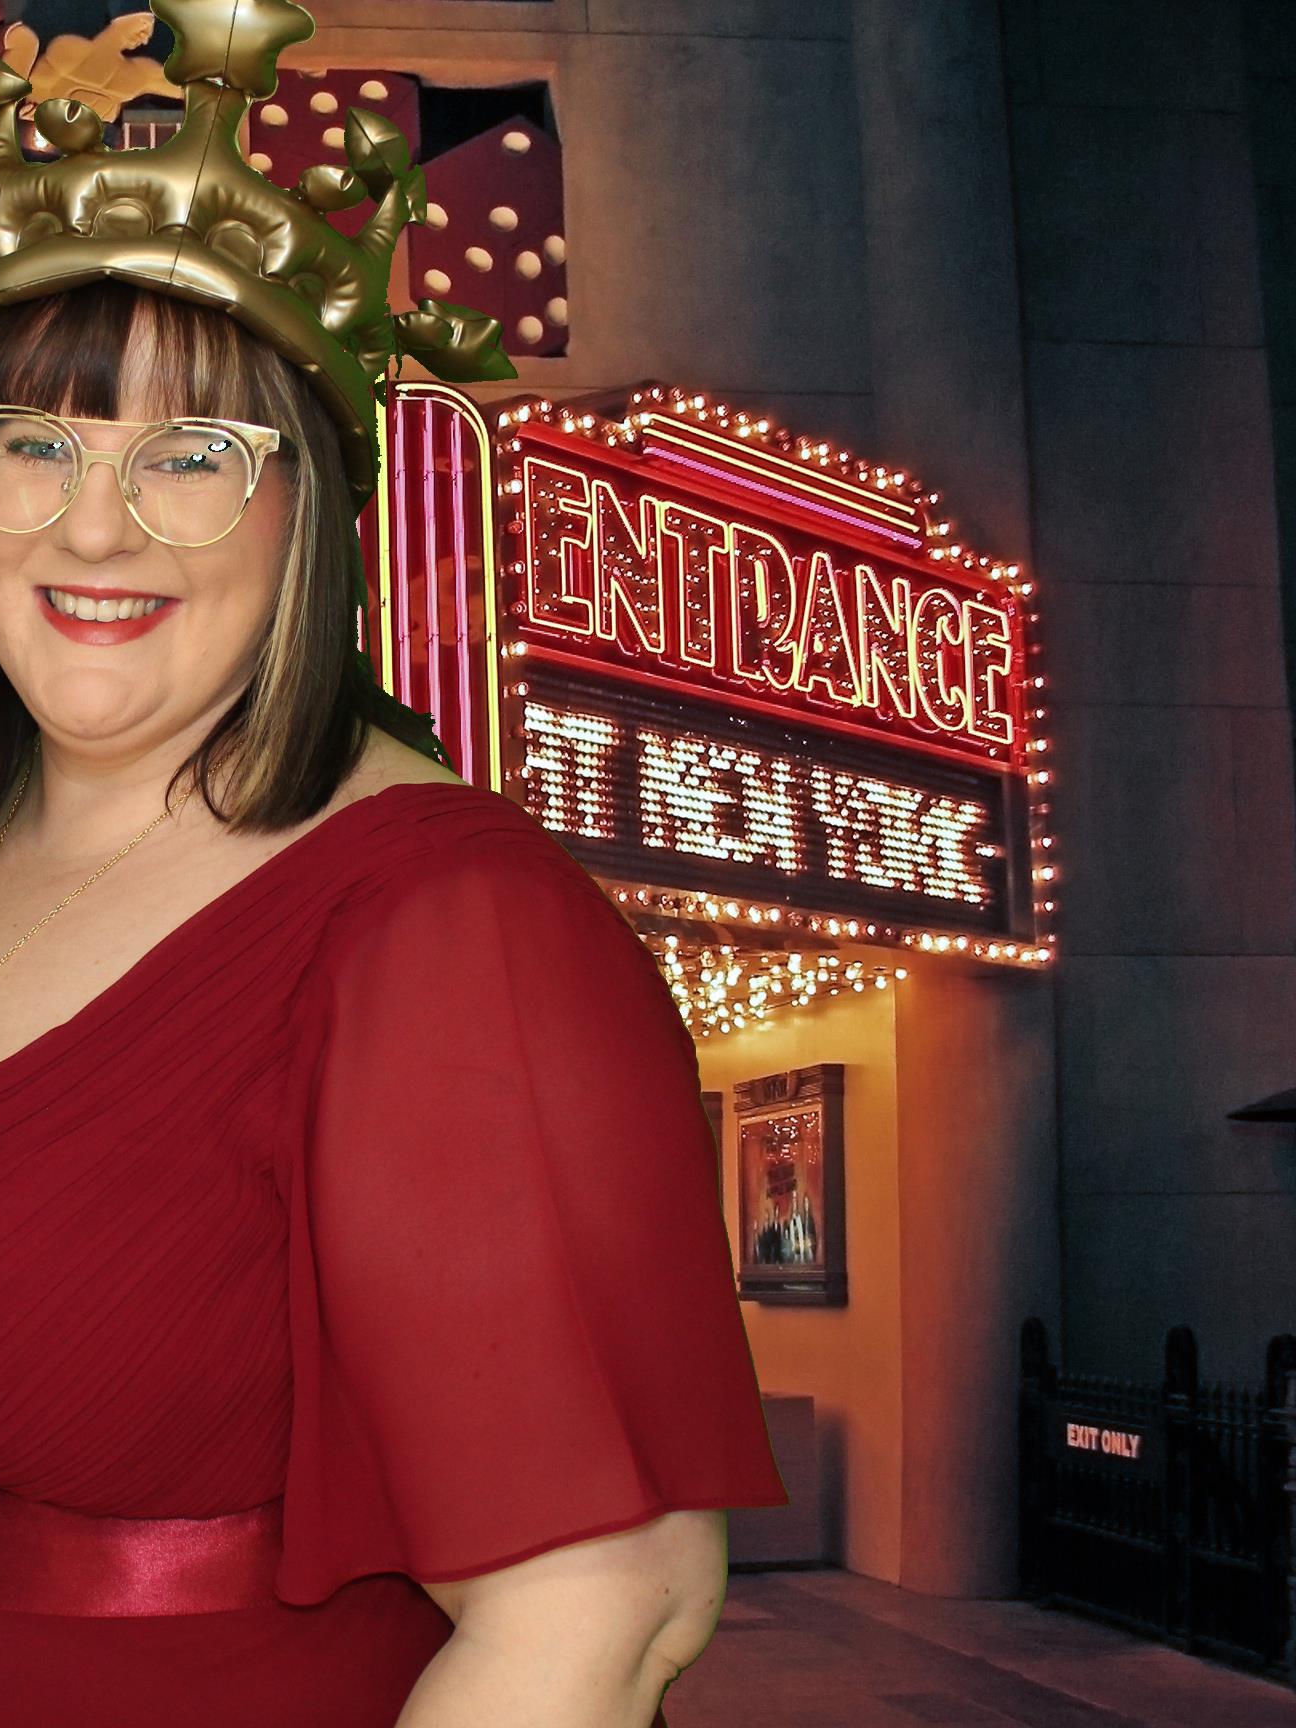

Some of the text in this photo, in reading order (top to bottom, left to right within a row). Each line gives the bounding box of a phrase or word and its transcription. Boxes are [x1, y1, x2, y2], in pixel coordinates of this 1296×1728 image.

[523, 456, 1017, 745] ENTRANCE
[1067, 1423, 1141, 1458] EXIT ONLY
